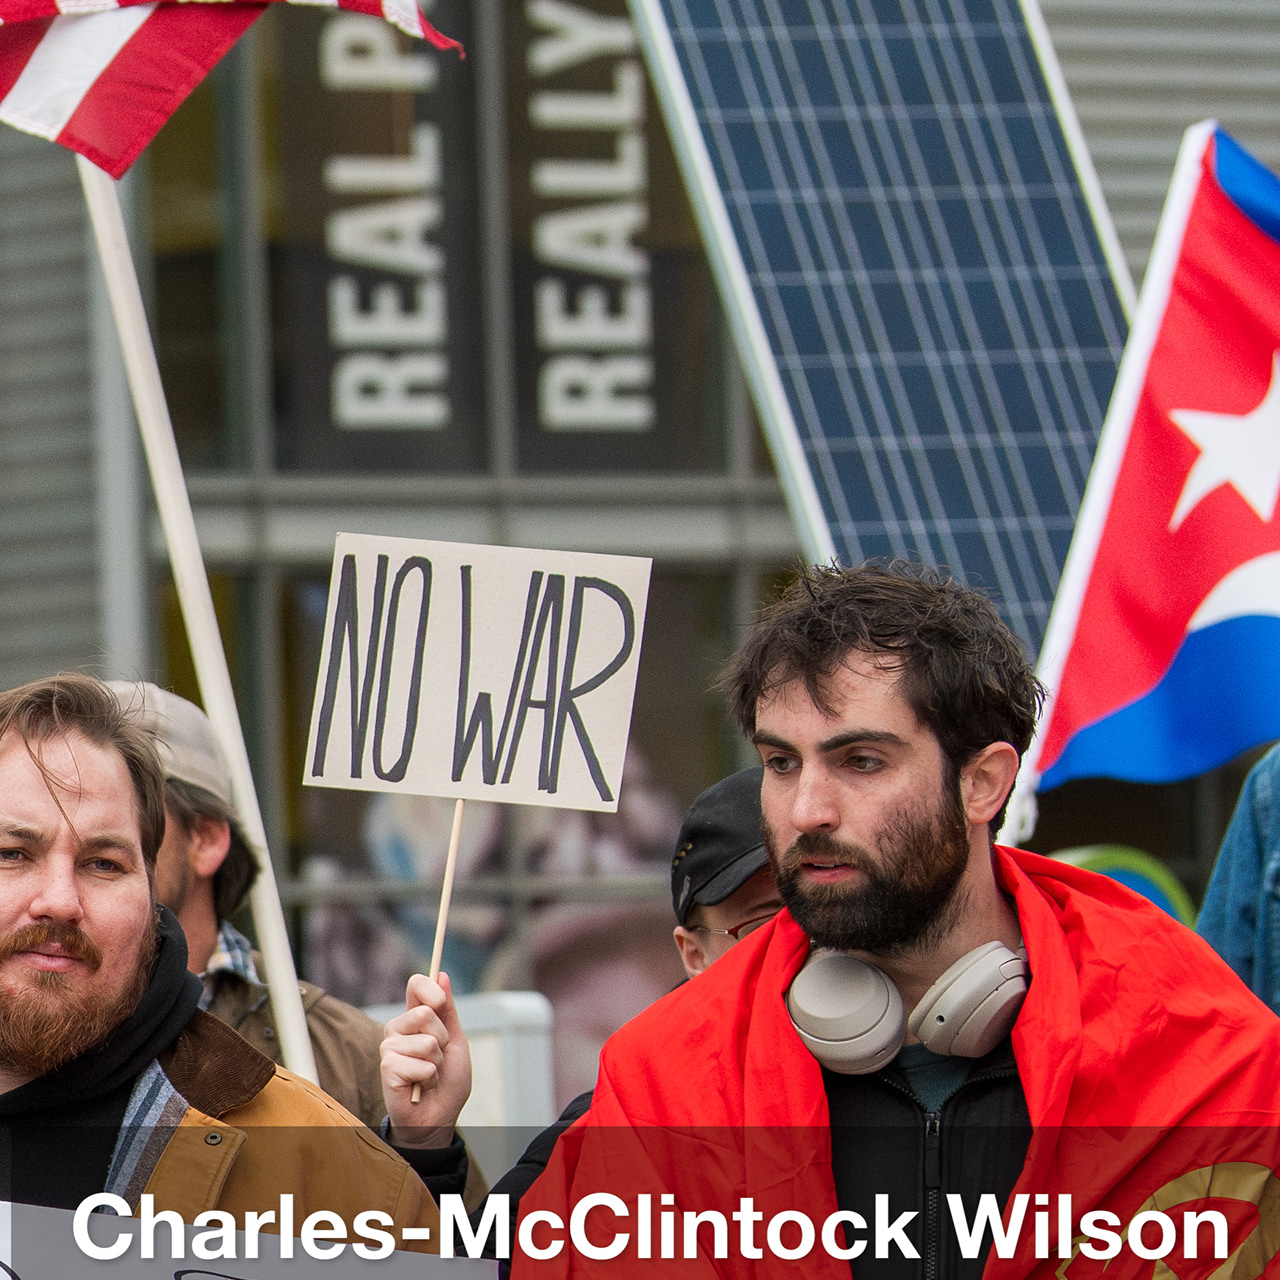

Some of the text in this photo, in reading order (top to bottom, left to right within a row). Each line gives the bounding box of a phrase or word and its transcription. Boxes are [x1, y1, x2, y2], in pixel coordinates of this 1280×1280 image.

[324, 120, 449, 430] REAL
[527, 0, 654, 431] REALLY
[312, 553, 637, 804] NO WAR
